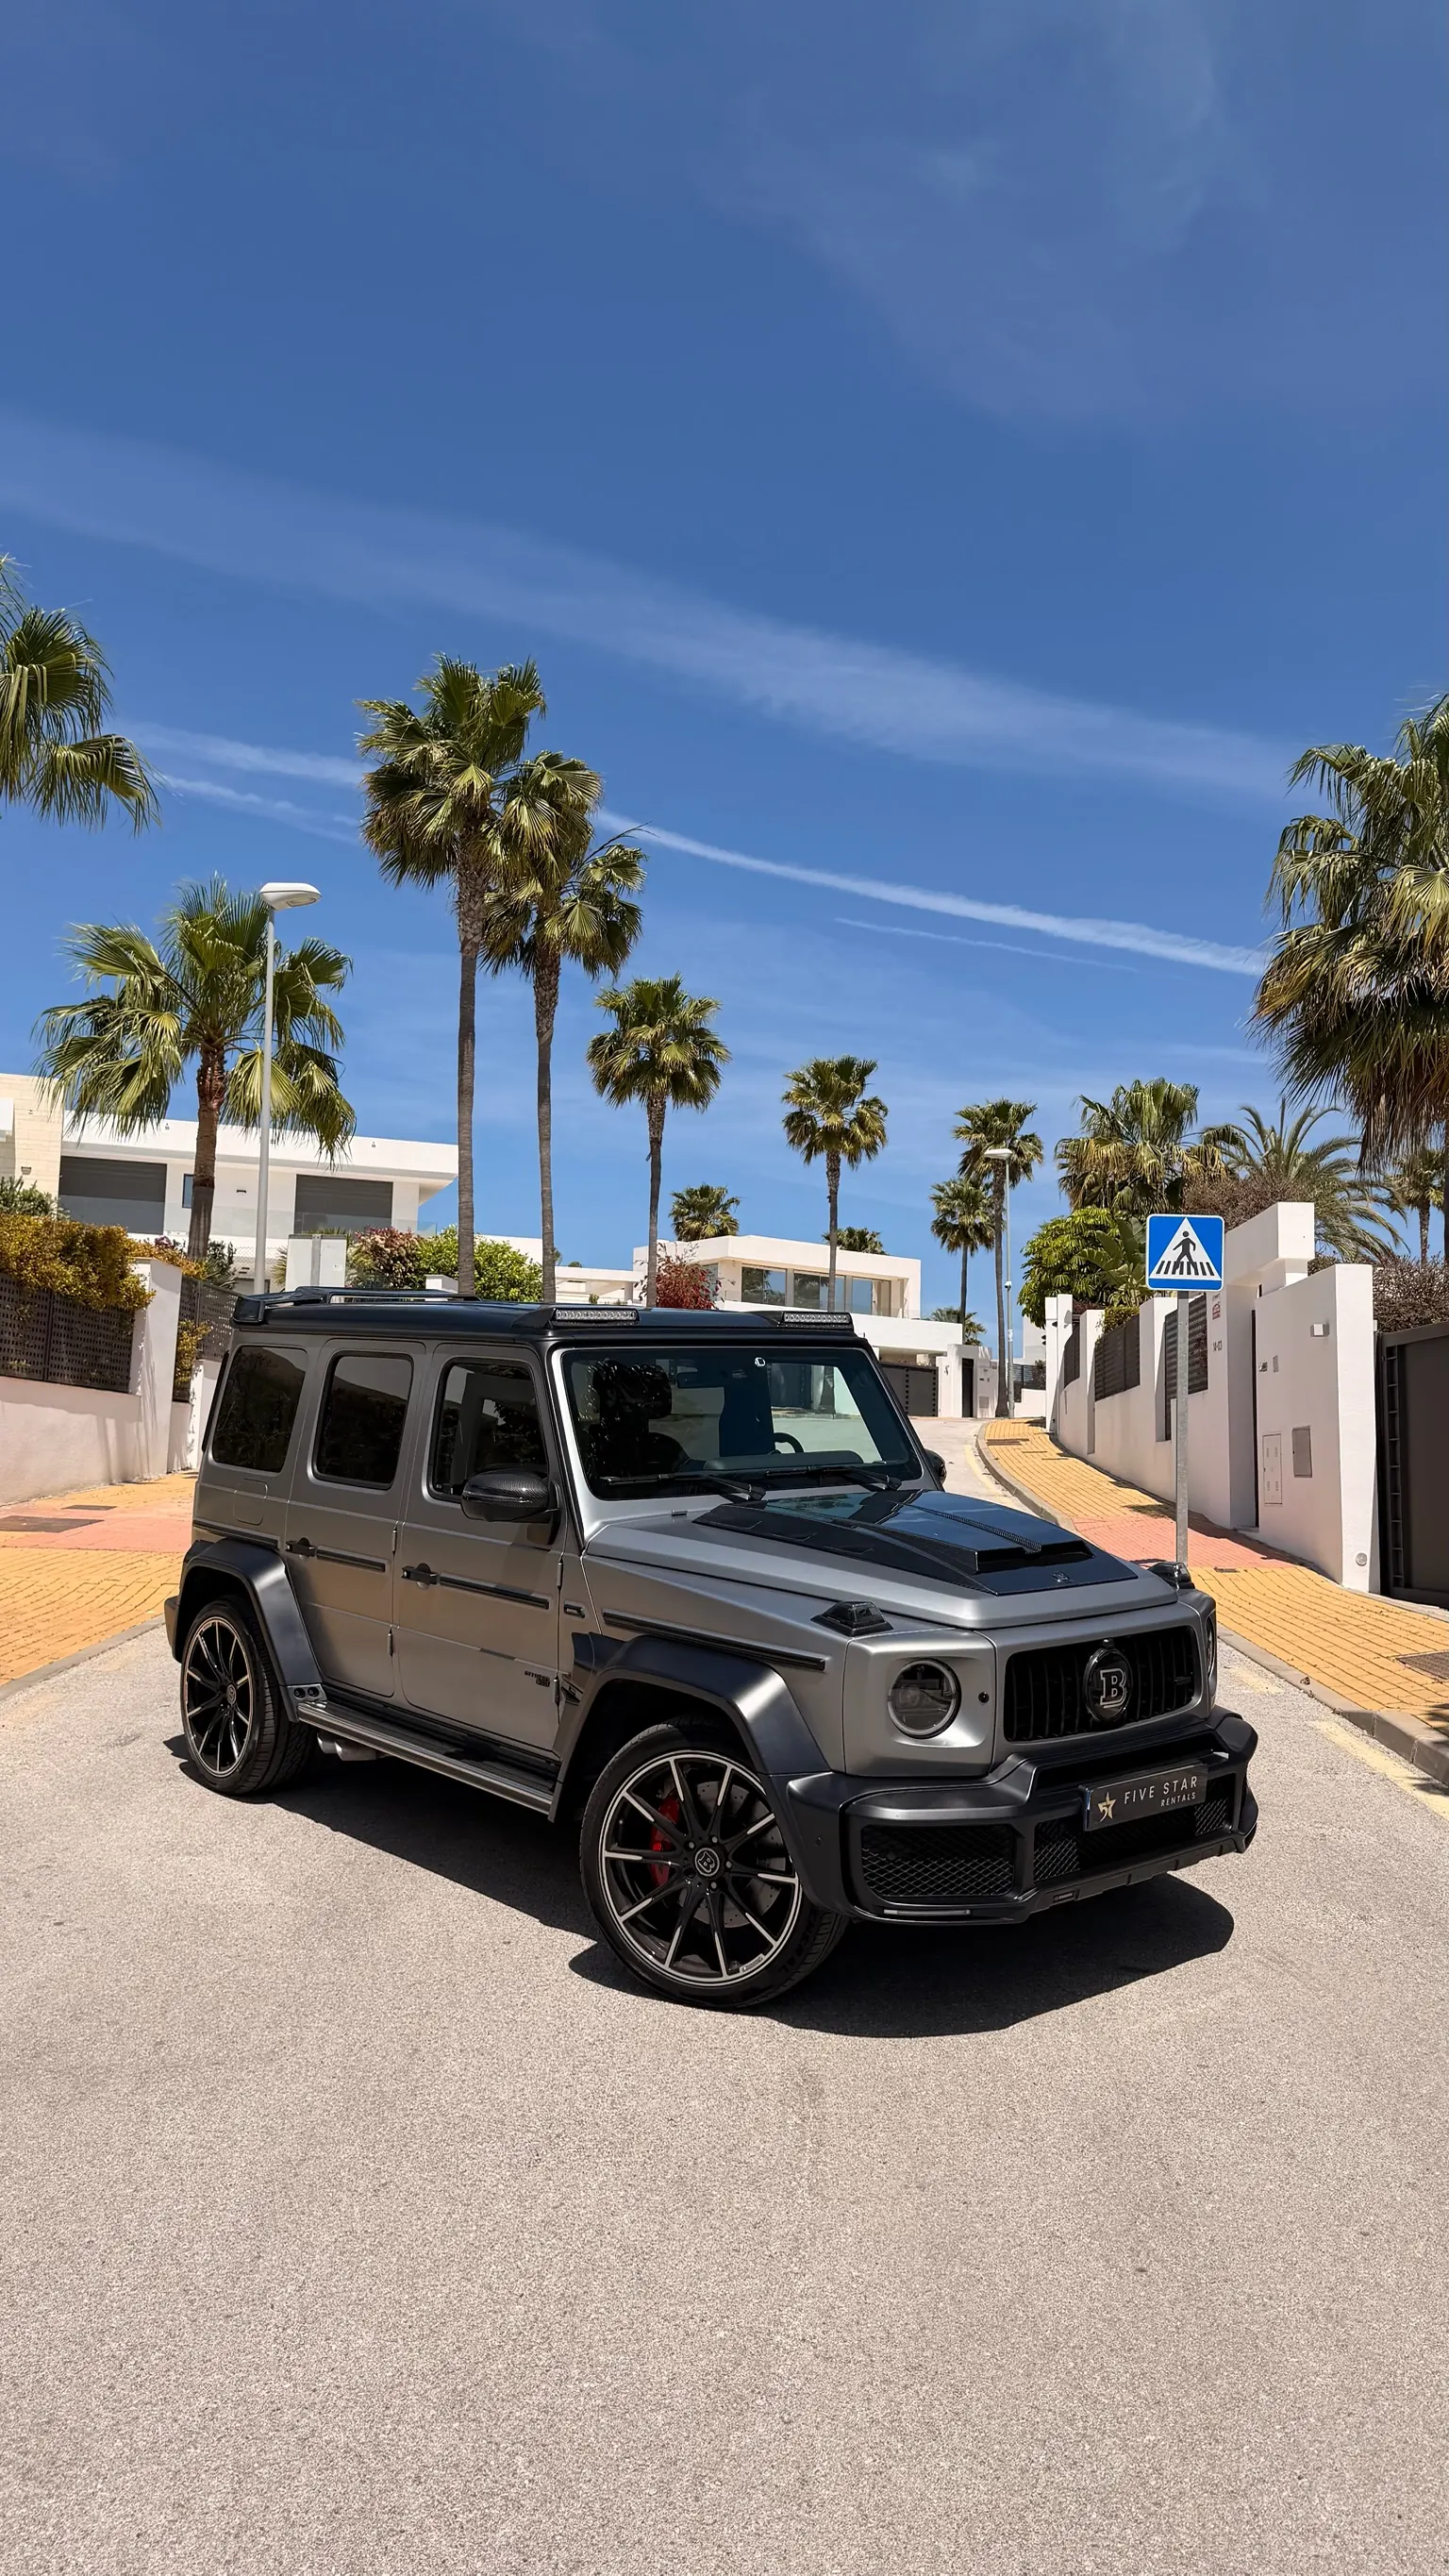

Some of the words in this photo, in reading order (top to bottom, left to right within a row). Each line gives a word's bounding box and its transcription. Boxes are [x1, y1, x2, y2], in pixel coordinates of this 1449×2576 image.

[1100, 1667, 1126, 1709] B
[1124, 1785, 1156, 1805] FIVE
[1163, 1776, 1197, 1795] STAR
[1160, 1792, 1196, 1807] RENTALS
[697, 1850, 715, 1873] B
